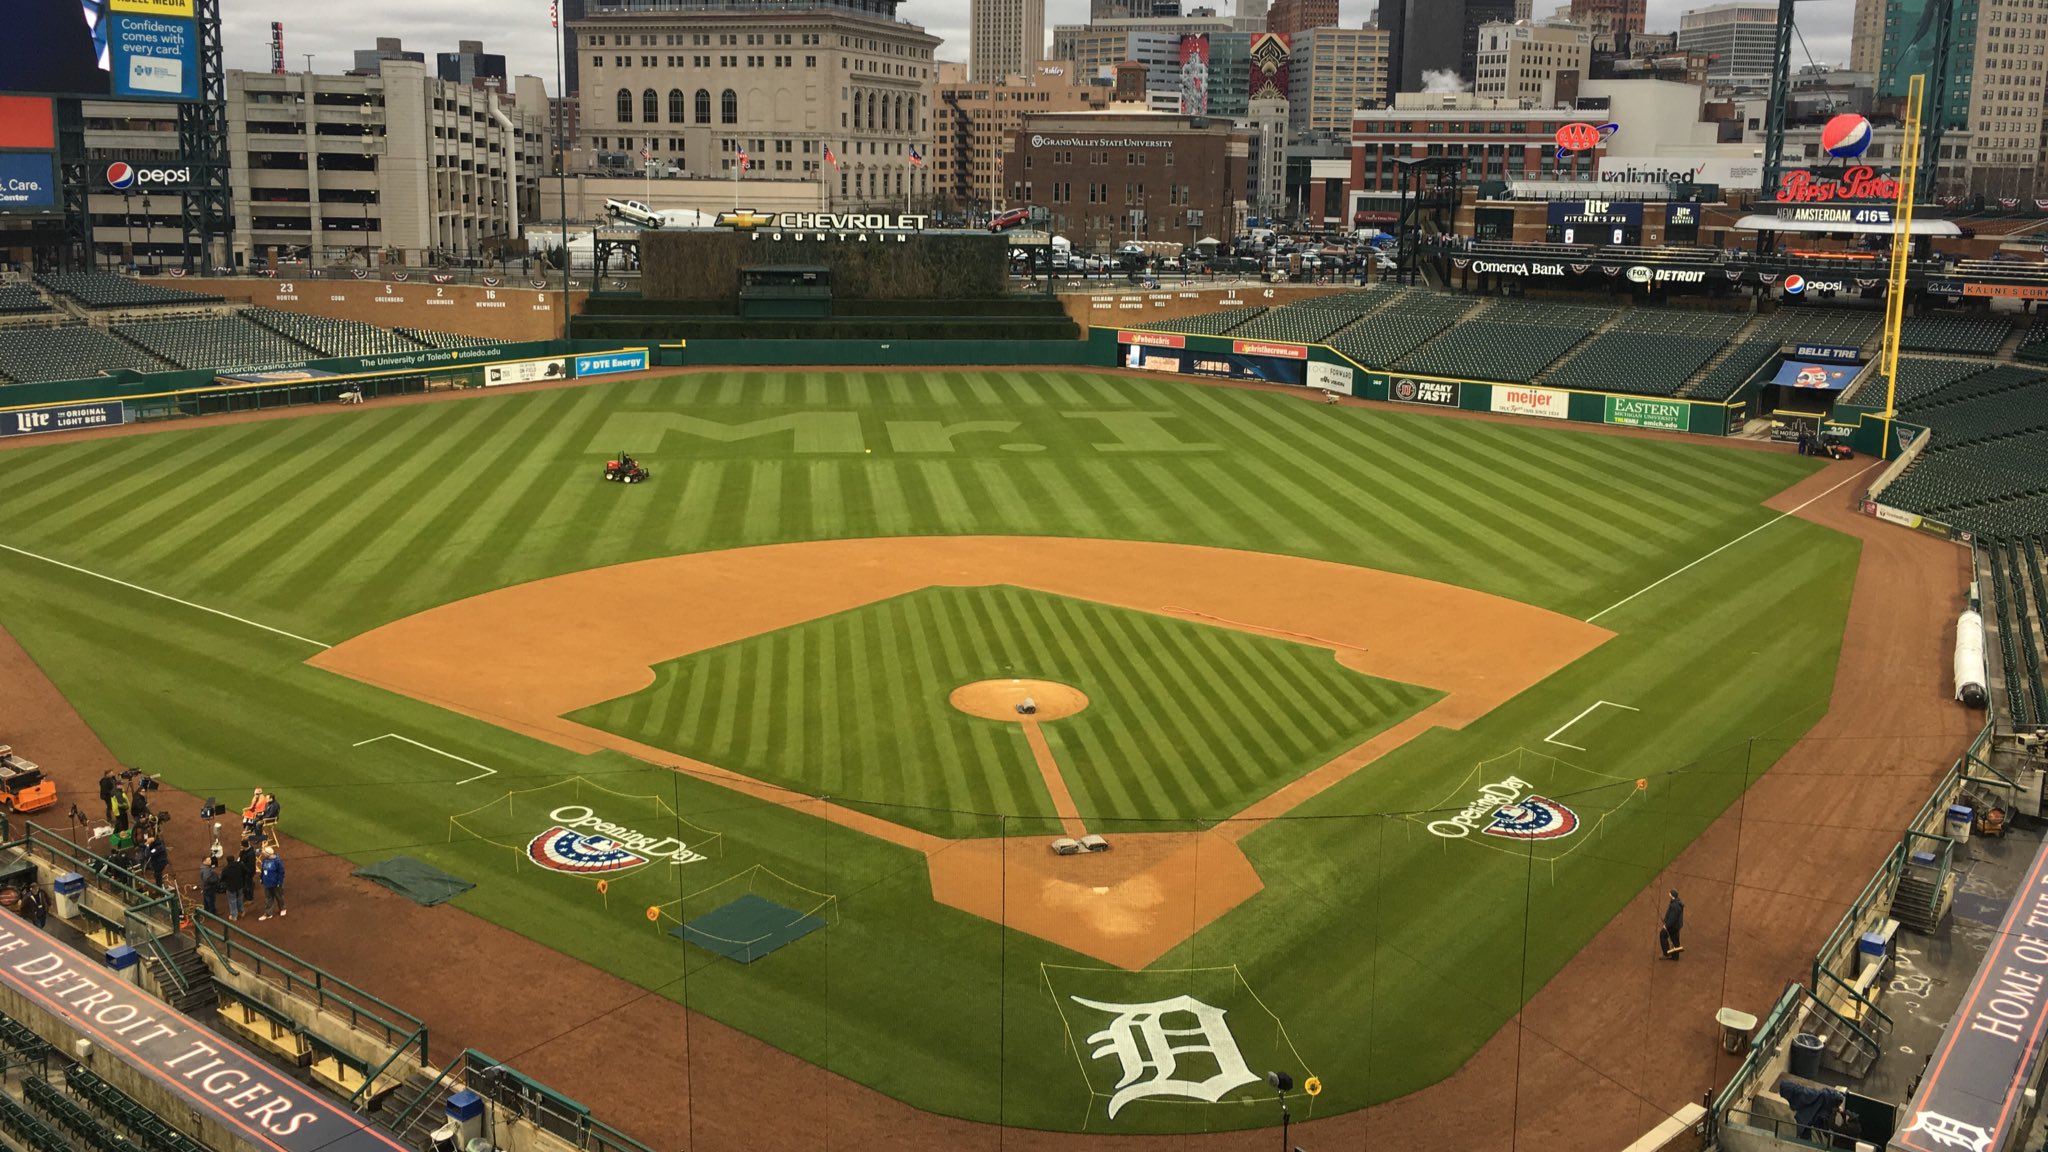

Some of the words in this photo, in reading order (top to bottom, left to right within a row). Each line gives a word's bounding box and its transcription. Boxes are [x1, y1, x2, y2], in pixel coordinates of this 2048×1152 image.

[121, 18, 184, 33] Confidence
[122, 32, 158, 42] comes
[161, 34, 184, 44] with
[123, 44, 153, 56] every
[156, 45, 182, 55] card.
[1043, 66, 1063, 76] Ashley
[1043, 138, 1071, 146] GRAND
[1071, 138, 1098, 147] VALLEY
[1100, 138, 1123, 147] STATE
[1124, 139, 1173, 147] UNIVERSITY
[138, 166, 190, 185] pepsi
[1601, 166, 1695, 184] unlimited
[9, 179, 42, 191] Care.
[1584, 200, 1610, 216] Lite
[1677, 207, 1691, 216] Lite
[1776, 207, 1794, 219] NEW
[1795, 208, 1851, 222] AMSTERDAM
[780, 212, 929, 230] CHEVROLET
[752, 233, 906, 242] FOUNTAIN
[1532, 263, 1565, 276] Bank
[1655, 270, 1705, 282] DETROIT
[280, 283, 293, 292] 23
[386, 285, 392, 294] 5
[437, 287, 443, 296] 2
[1806, 280, 1842, 292] pepsi
[486, 290, 495, 299] 16
[538, 293, 544, 302] 6
[1228, 290, 1236, 298] 11
[1263, 289, 1274, 298] 42
[361, 359, 376, 367] The
[378, 353, 415, 366] University
[417, 354, 425, 362] of
[426, 352, 451, 361] Toledo
[459, 349, 501, 358] utoledo.edu
[1798, 347, 1831, 357] BELLE
[1833, 349, 1857, 359] TIRE
[216, 361, 306, 374] motorcitycasino.com
[593, 360, 610, 369] DTE
[612, 358, 642, 368] Energy
[1330, 368, 1352, 379] FORWARD
[1420, 382, 1453, 392] FREAKY
[1417, 390, 1452, 403] FAST!
[1507, 389, 1552, 407] meijer
[66, 408, 106, 418] ORIGINAL
[1615, 398, 1680, 416] EASTERN
[16, 412, 50, 432] Lite
[58, 418, 82, 426] LIGHT
[84, 415, 107, 424] BEER
[1644, 414, 1678, 422] UNIVERSITY
[1644, 420, 1678, 429] emich.edu
[1427, 791, 1509, 838] Opening
[1478, 776, 1534, 801] Day
[550, 805, 653, 850] Opening
[639, 836, 707, 865] Day
[1971, 966, 2045, 1043] HOME
[12, 950, 178, 1047] DETROIT
[164, 1040, 318, 1137] TIGERS
